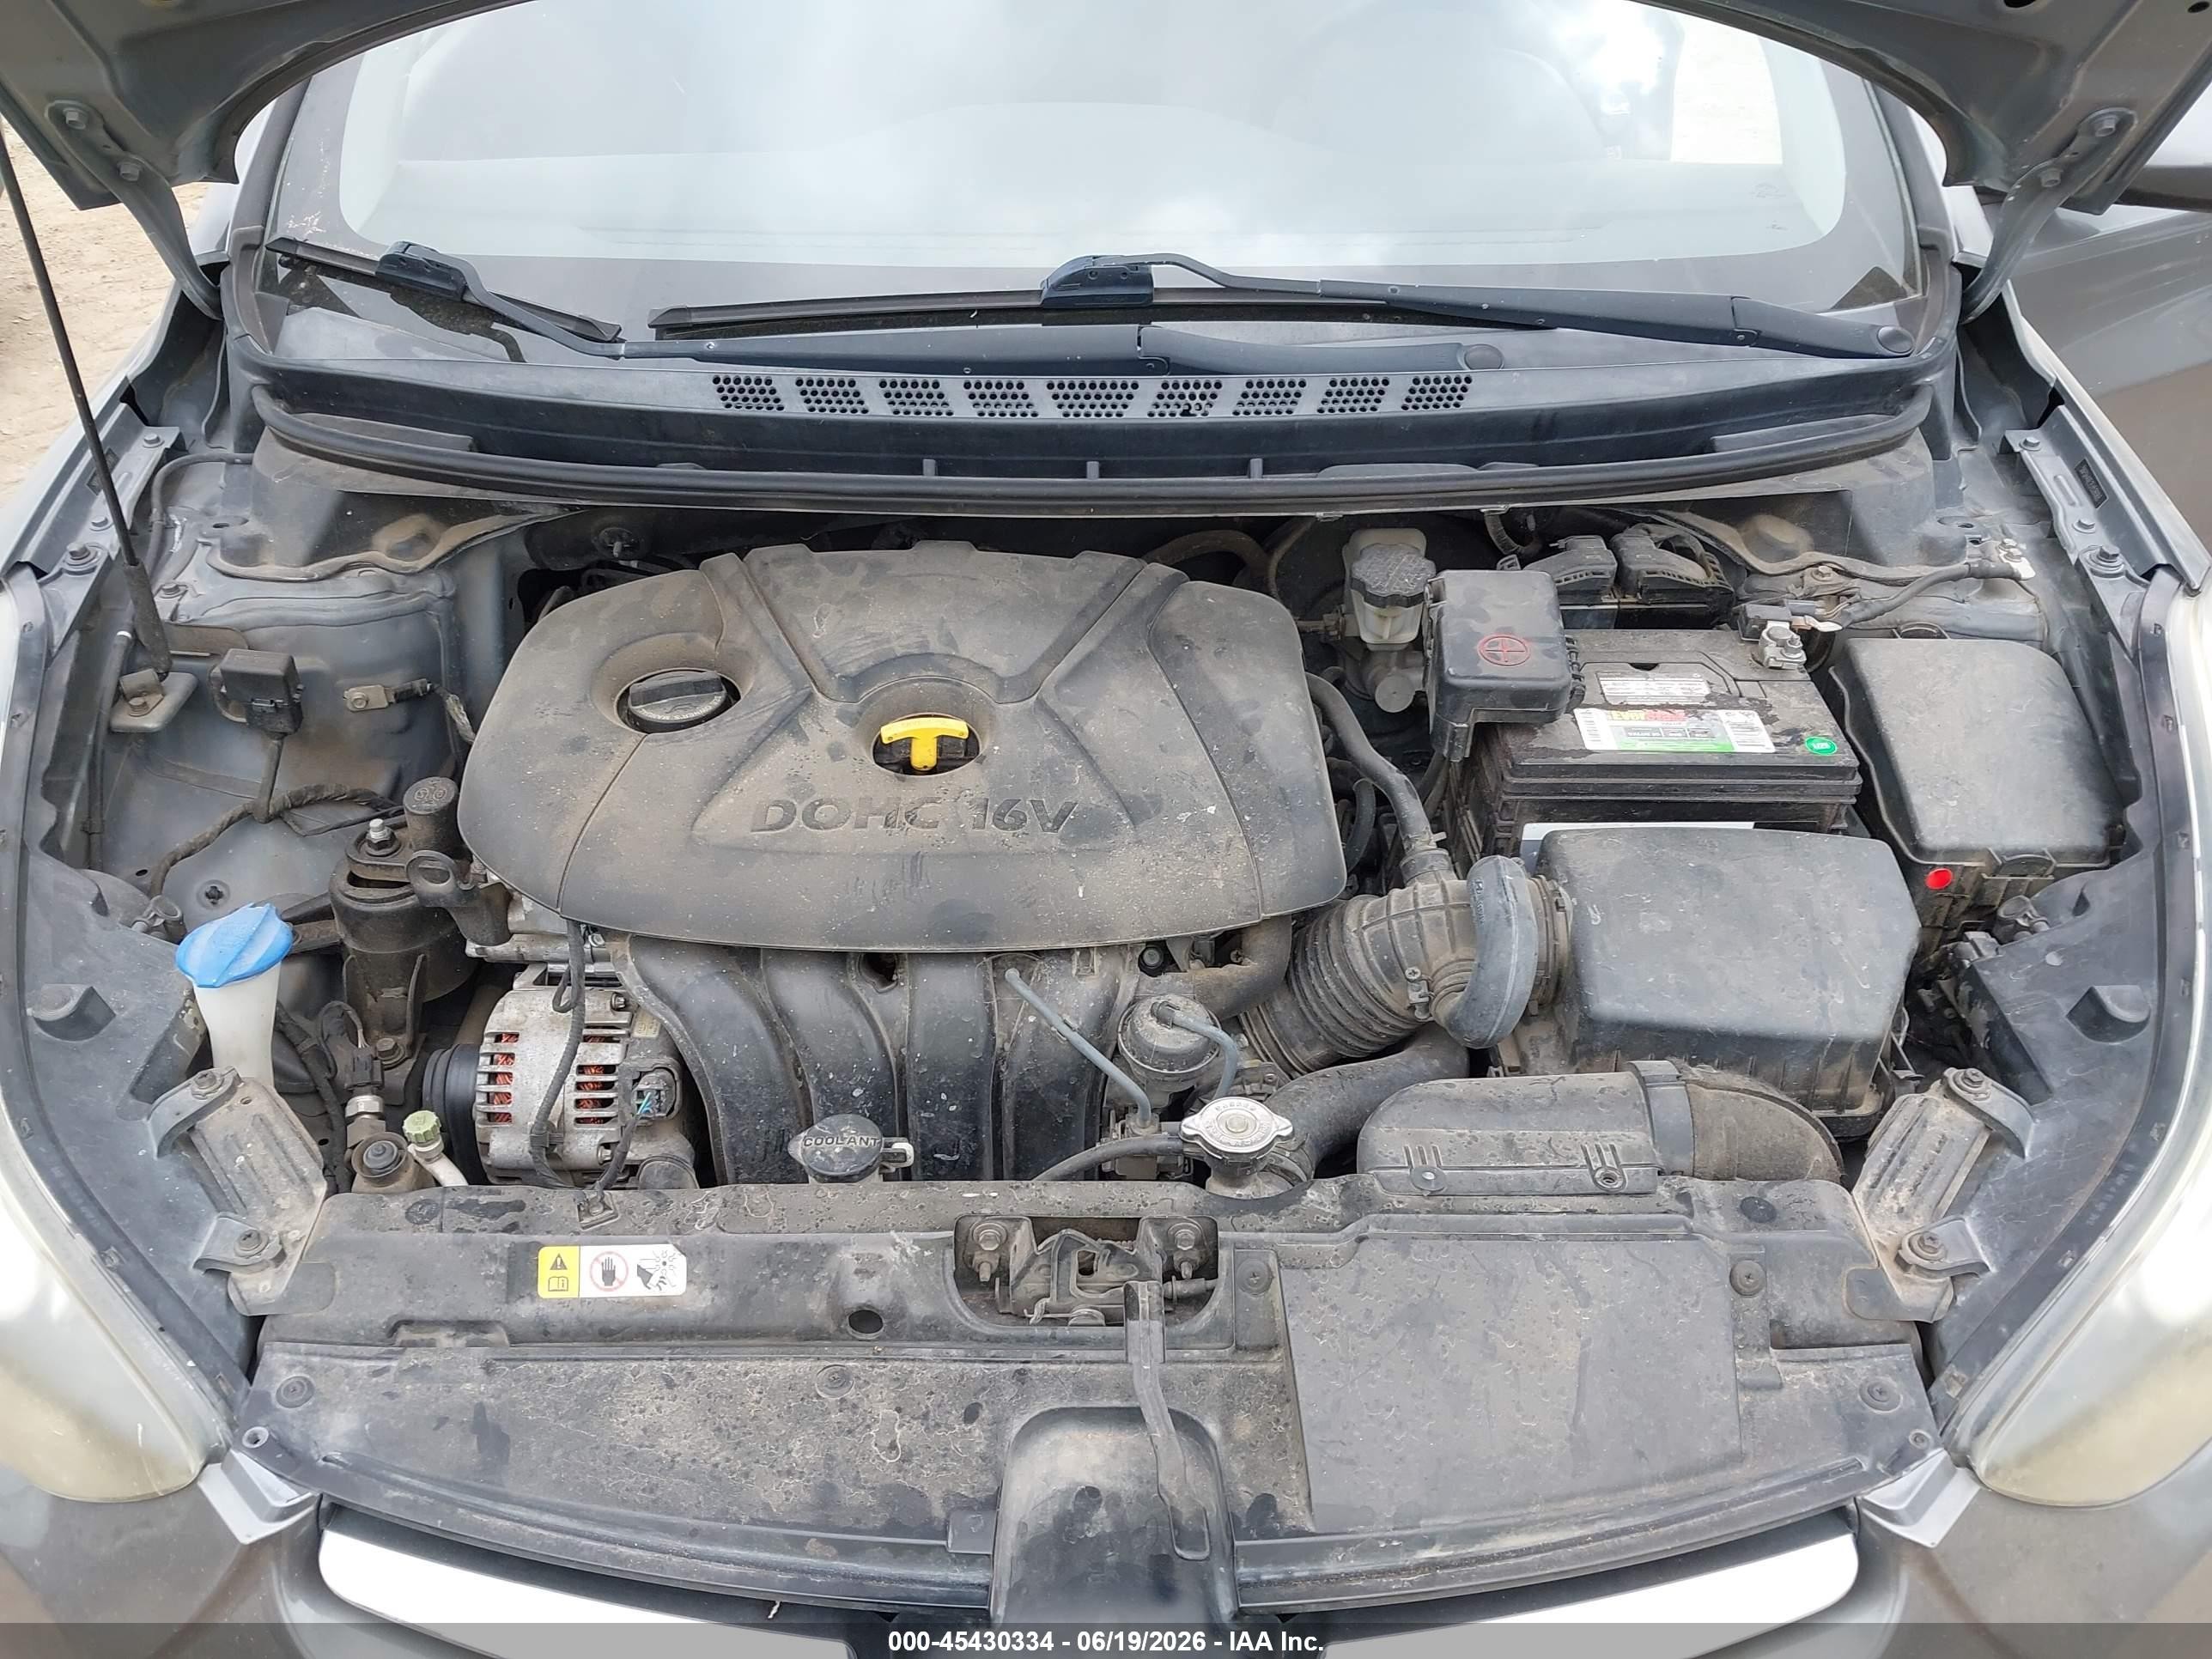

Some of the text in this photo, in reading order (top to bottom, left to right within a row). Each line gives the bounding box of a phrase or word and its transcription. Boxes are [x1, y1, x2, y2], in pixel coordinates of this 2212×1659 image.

[750, 798, 1079, 833] DOHC 16V
[803, 1135, 881, 1148] COOLANT
